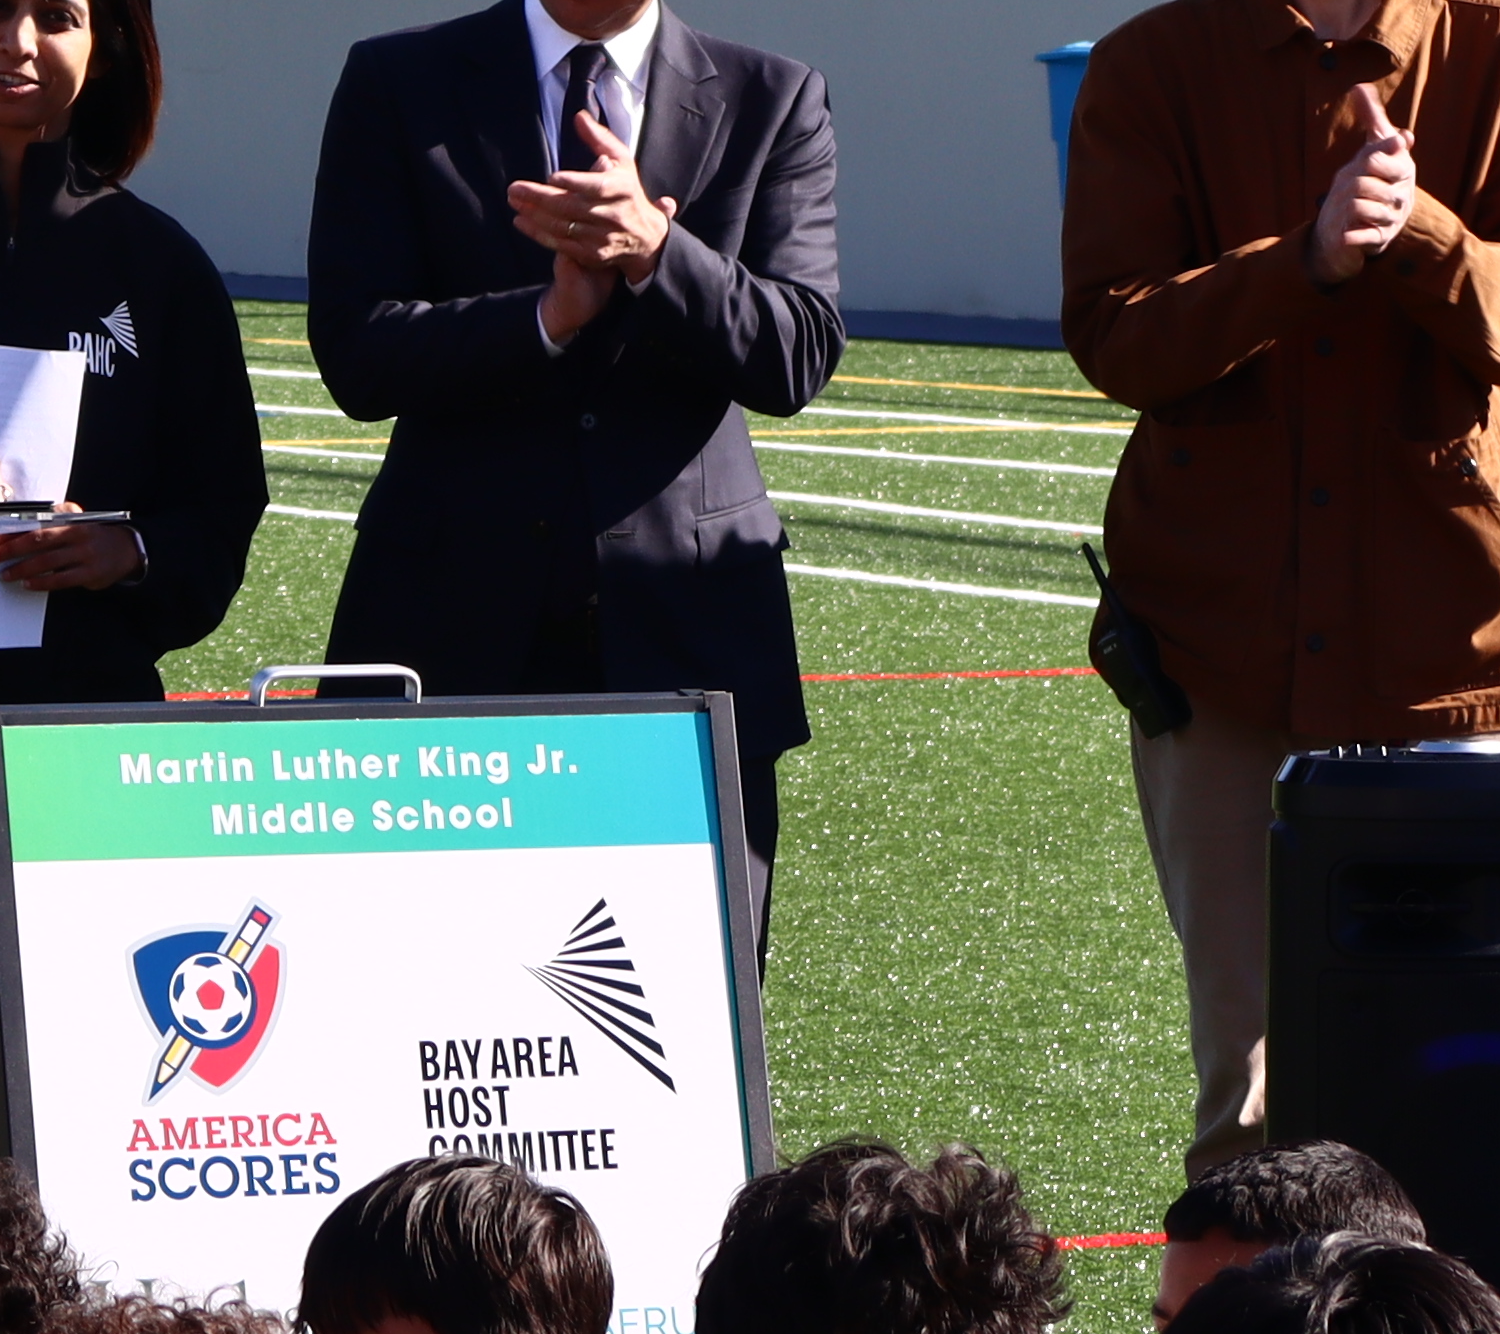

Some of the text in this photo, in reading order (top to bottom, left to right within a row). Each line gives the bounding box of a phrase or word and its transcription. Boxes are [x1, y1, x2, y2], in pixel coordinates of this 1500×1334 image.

[119, 743, 579, 785] Martin Luther King Jr.
[211, 796, 514, 836] Middle School
[418, 1035, 579, 1081] BAY AREA
[423, 1085, 510, 1129] HOST
[126, 1112, 337, 1152] AMERICA
[129, 1151, 341, 1202] SCORES
